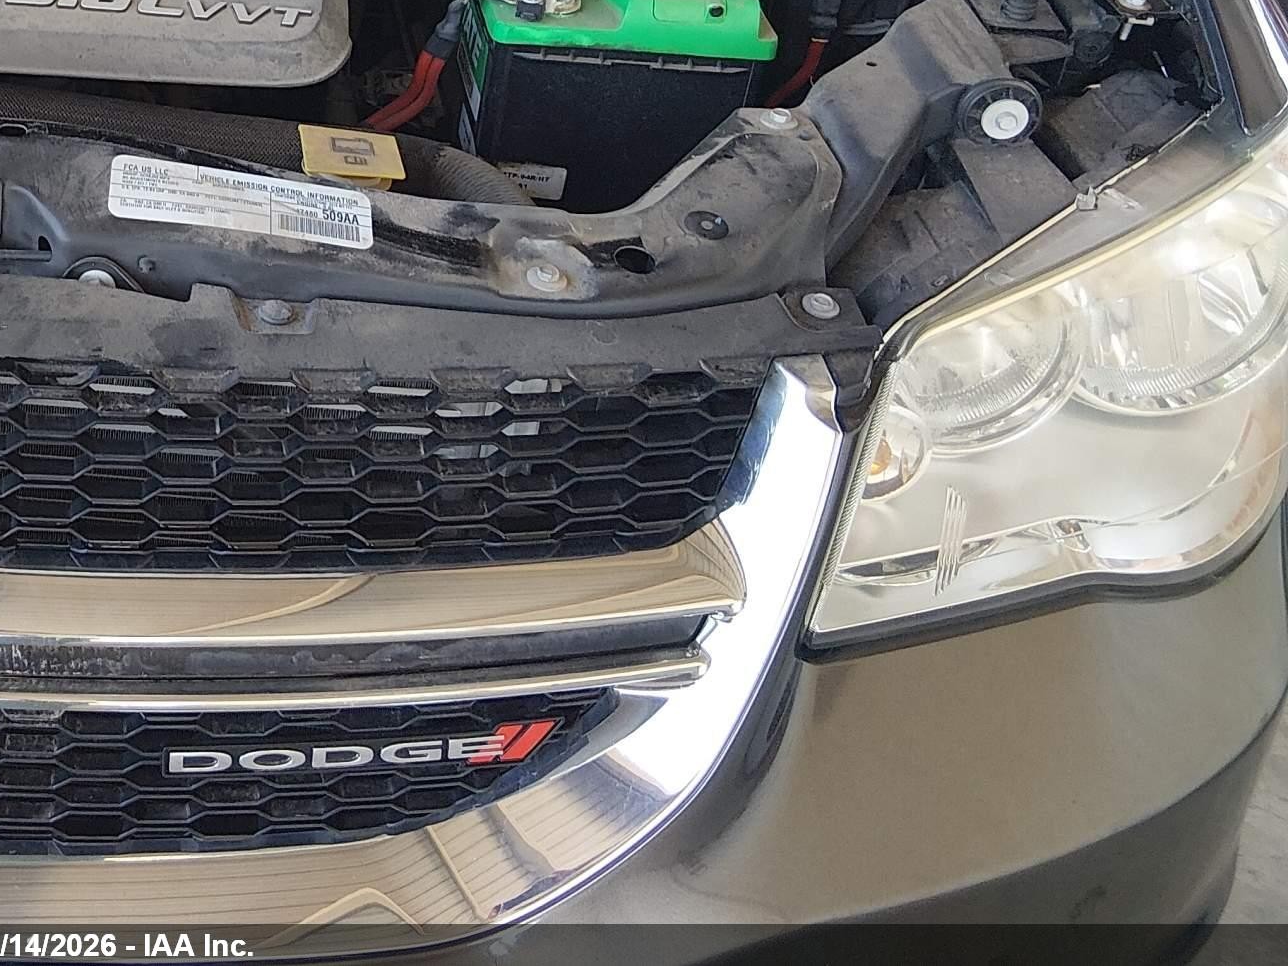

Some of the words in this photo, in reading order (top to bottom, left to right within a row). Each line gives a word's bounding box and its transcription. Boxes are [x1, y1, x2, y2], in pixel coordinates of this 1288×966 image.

[123, 163, 139, 172] FCA
[199, 173, 230, 186] VEHICLE
[232, 179, 268, 191] EMISSION
[270, 185, 303, 196] CONTROL
[307, 191, 359, 206] INFORMATION
[322, 208, 360, 226] 509AA
[168, 734, 505, 774] DODGE
